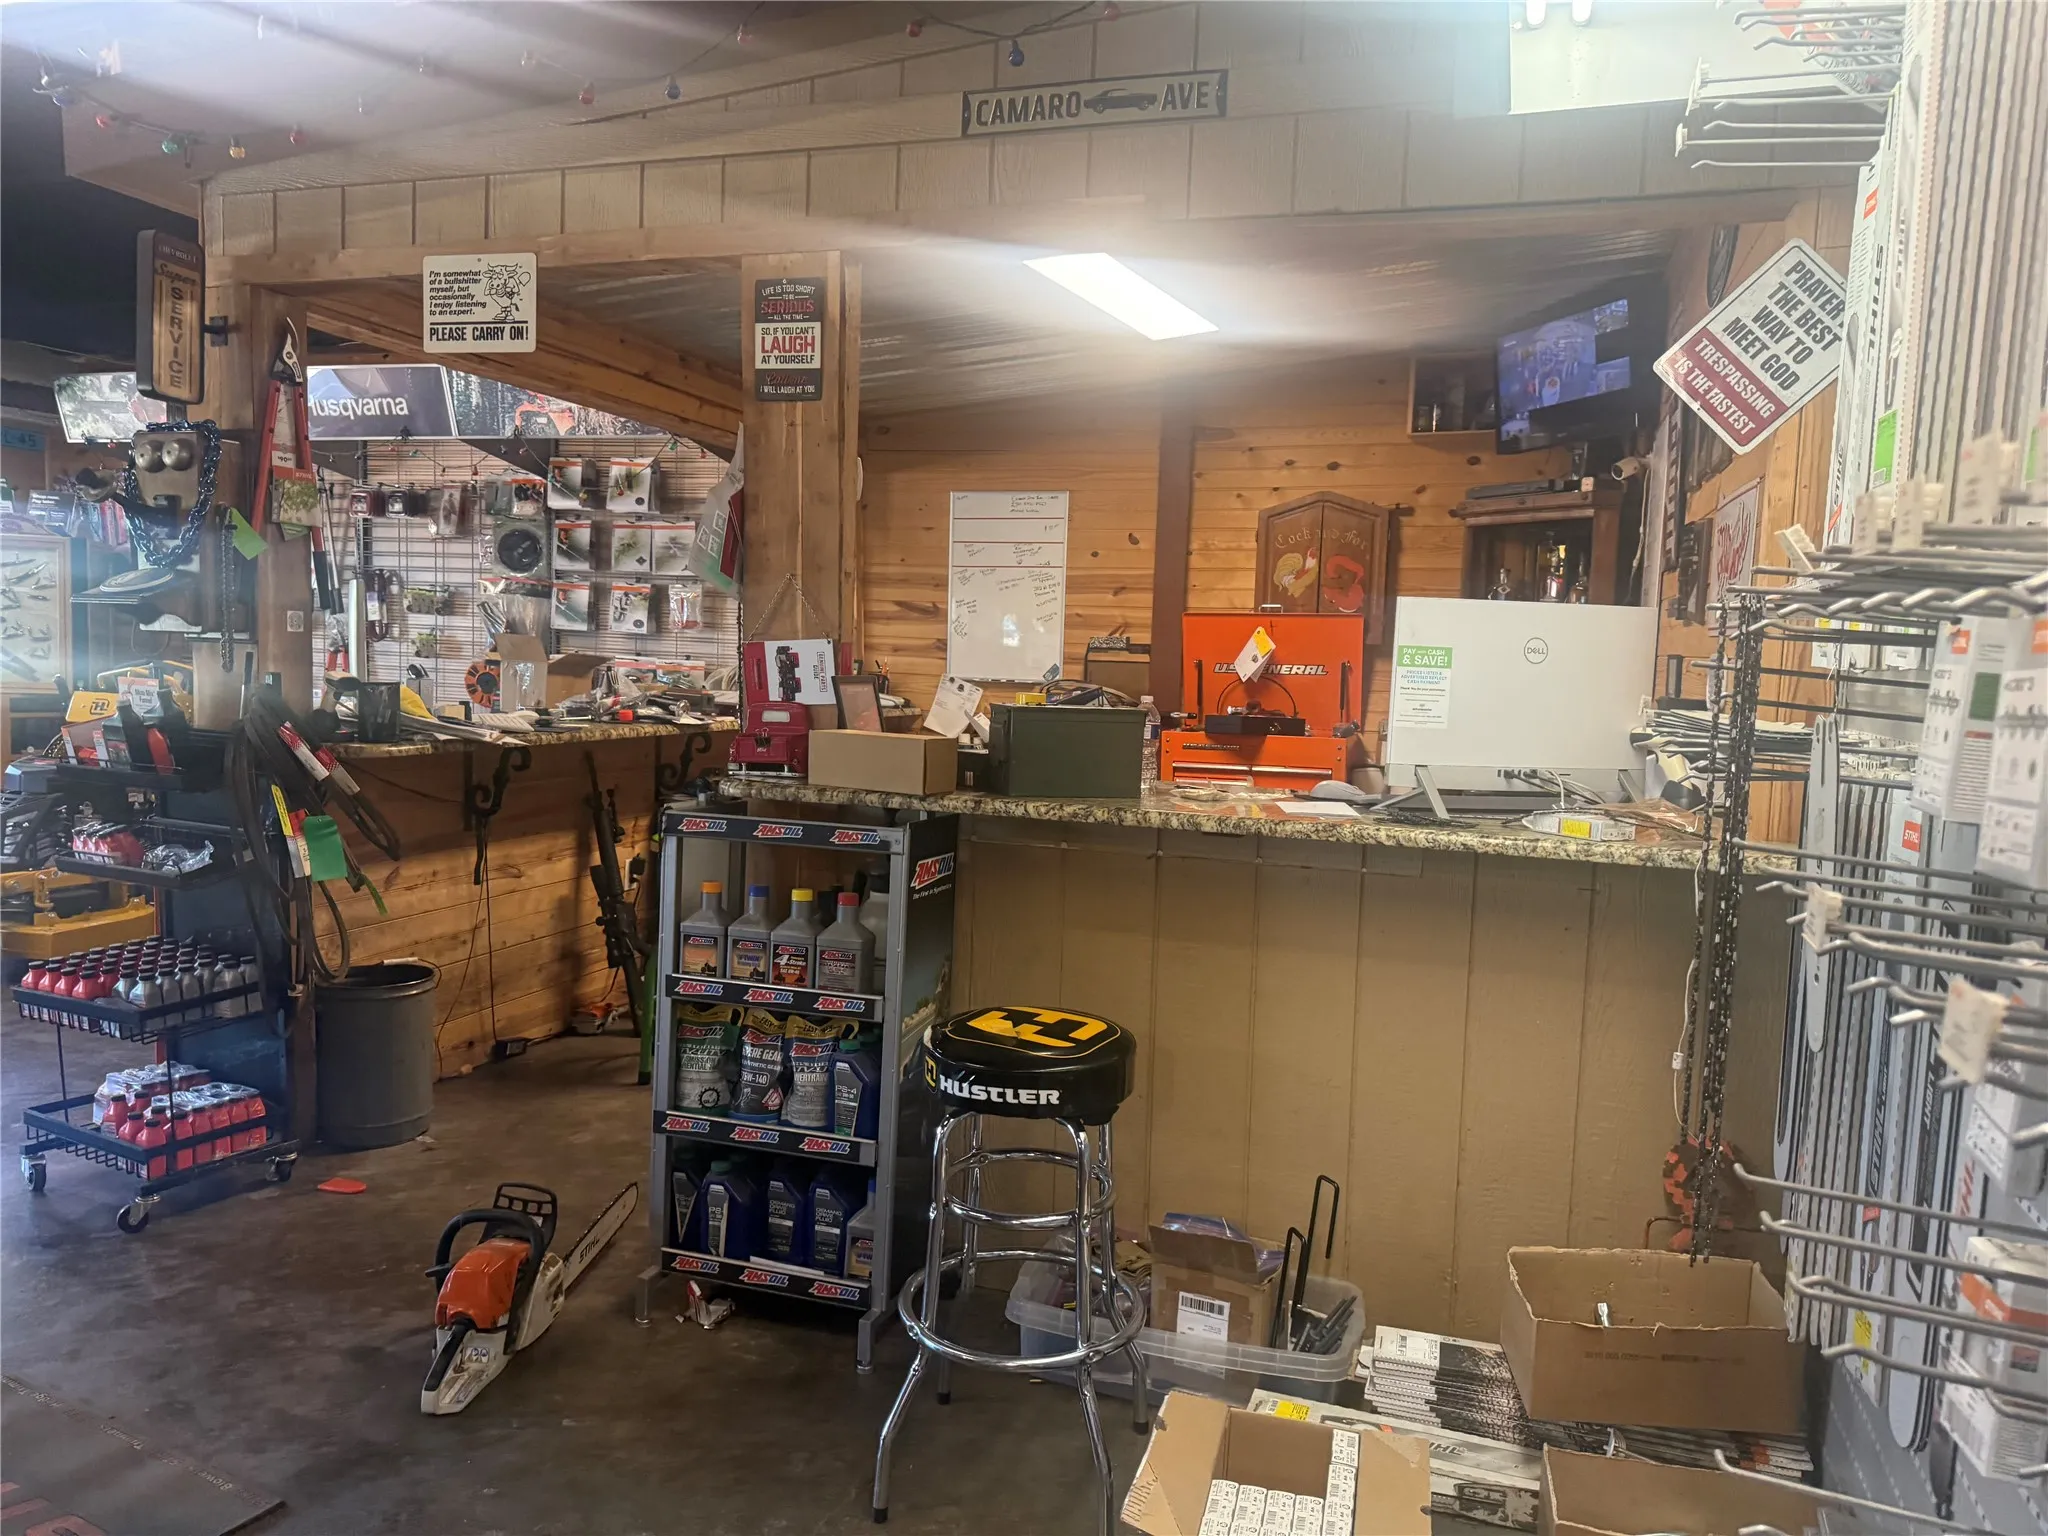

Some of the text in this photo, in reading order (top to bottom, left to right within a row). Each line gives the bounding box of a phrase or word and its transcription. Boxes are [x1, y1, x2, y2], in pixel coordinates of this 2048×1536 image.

[976, 81, 1210, 127] CAMARO AVE
[157, 263, 197, 286] Super
[429, 286, 456, 294] myself,
[429, 293, 475, 301] occasionally
[762, 284, 815, 296] LIFE IS TOO SHORT
[761, 300, 815, 314] SERIOUS
[1867, 243, 1884, 364] STIHL
[1767, 281, 1842, 352] THE BEST
[168, 287, 185, 389] SERVICE
[429, 327, 467, 341] PLEASE
[472, 326, 505, 340] CARRY
[773, 327, 779, 335] IF
[780, 327, 794, 335] YOU
[795, 326, 815, 335] CAN'T
[1751, 305, 1814, 365] WAY TO
[761, 336, 815, 354] LAUGH
[1722, 317, 1801, 391] MEET GOD
[761, 354, 815, 364] AT YOURSELF
[1694, 337, 1776, 419] TRESPASSING
[764, 385, 776, 393] WILL
[777, 386, 795, 394] LAUGH
[796, 385, 803, 393] AT
[804, 385, 815, 393] YOU
[1674, 355, 1756, 435] IS THE FASTEST
[1402, 654, 1448, 666] & SAVE!
[1526, 647, 1546, 655] DELL
[1262, 663, 1329, 675] ENERAL
[678, 817, 881, 845] AMSOIL AMSOIL AMSOIL
[1904, 829, 1919, 844] STIHL
[910, 852, 955, 889] AMSOIL
[688, 936, 715, 945] AMSOIL
[736, 941, 763, 950] AMSOIL
[776, 945, 806, 955] AMSOIL
[822, 950, 853, 960] AMSOIL
[674, 980, 866, 1013] AMSOIL AMSOIL AMSOIL
[678, 1023, 725, 1039] AMSOIL
[939, 1074, 1060, 1105] HUSTLER
[1924, 1070, 1935, 1130] LIGHT
[661, 1115, 851, 1155] AMSOIL AMSOIL AMSOIL
[1869, 1102, 1884, 1193] STIHL
[579, 1236, 600, 1265] STIHL
[670, 1255, 860, 1300] AMSOIL AMSOIL AMSOIL
[1429, 1442, 1462, 1456] IHL
